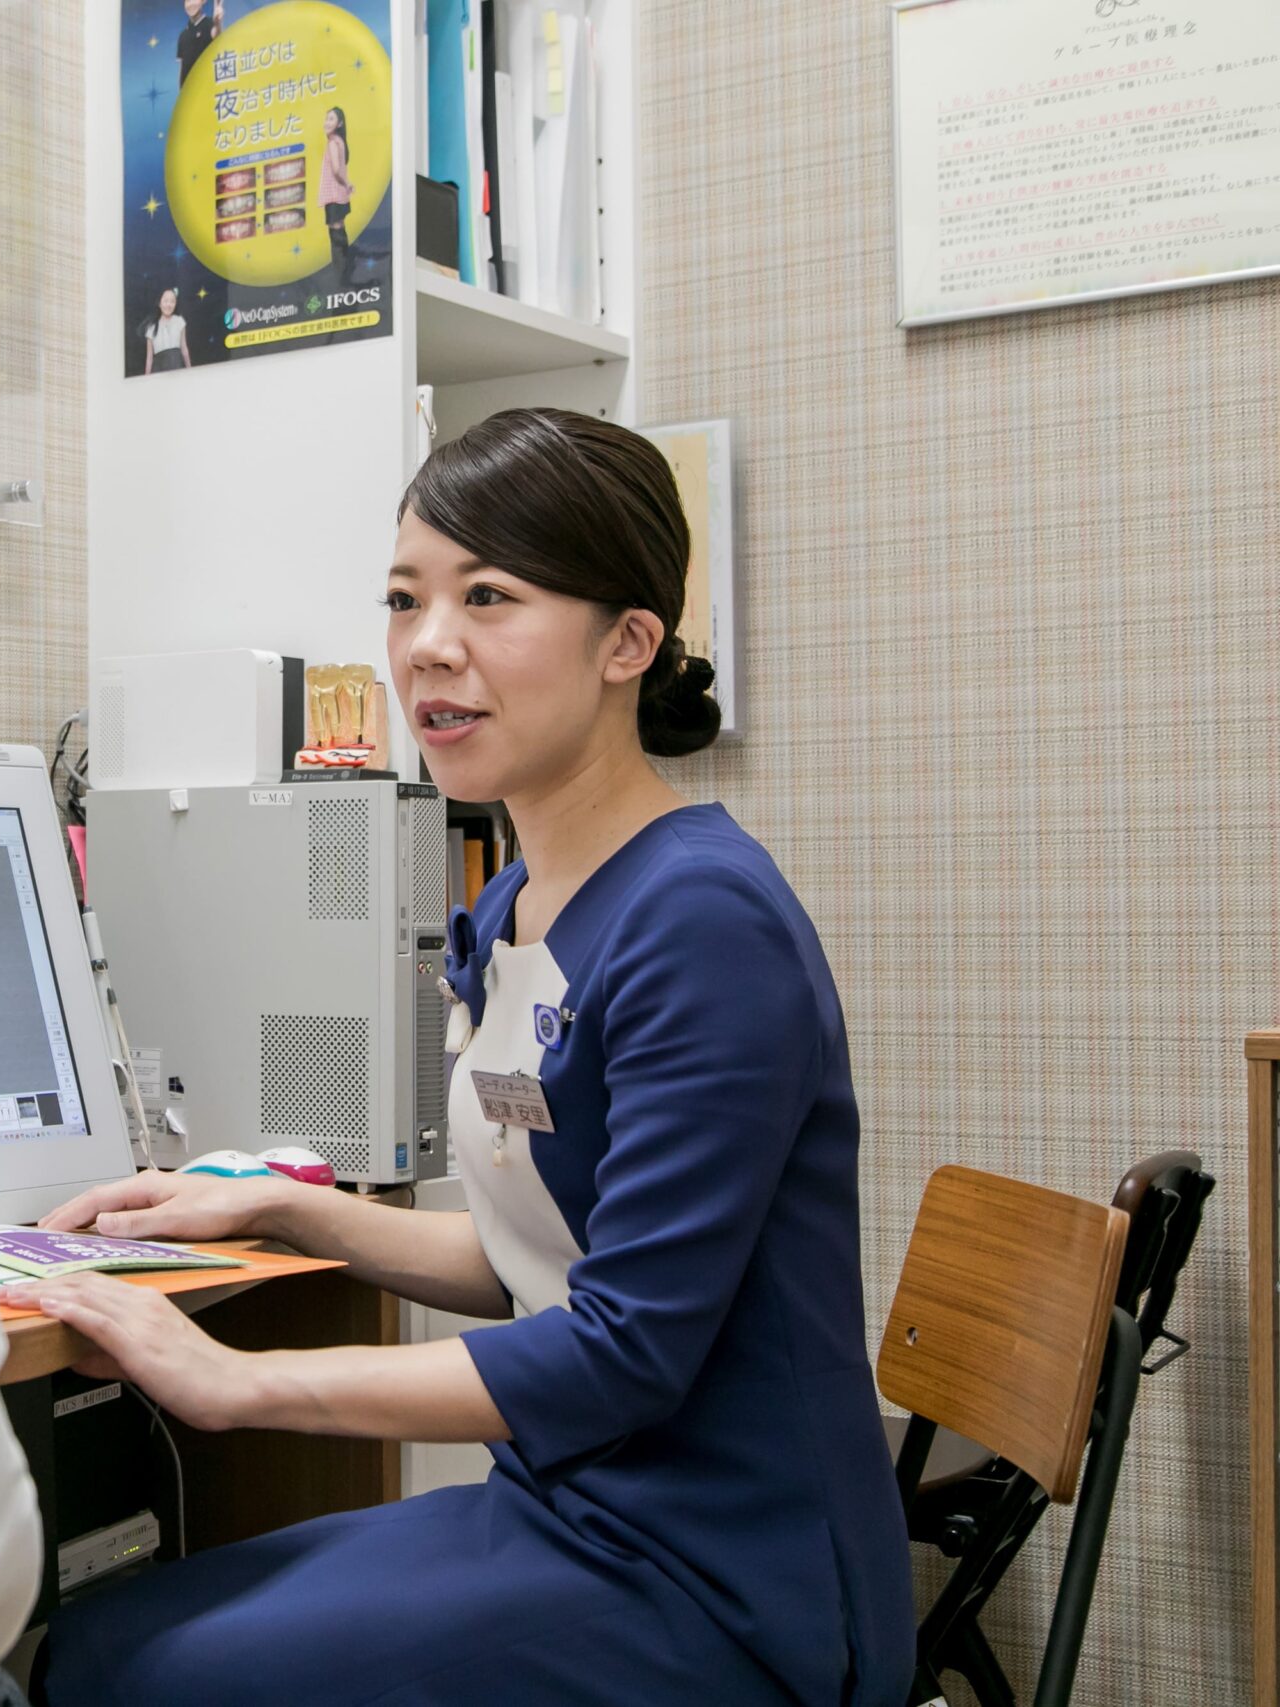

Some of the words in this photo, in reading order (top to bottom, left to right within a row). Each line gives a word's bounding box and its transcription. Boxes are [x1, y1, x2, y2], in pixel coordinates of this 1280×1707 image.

[1054, 20, 1197, 61] グループ医療理念
[213, 40, 297, 83] 歯並びは
[214, 71, 337, 122] 夜治す時代に
[215, 113, 304, 150] なりました
[326, 287, 381, 309] IFOCS
[477, 1078, 537, 1094] コーディネーター
[516, 1104, 548, 1126] 安里
